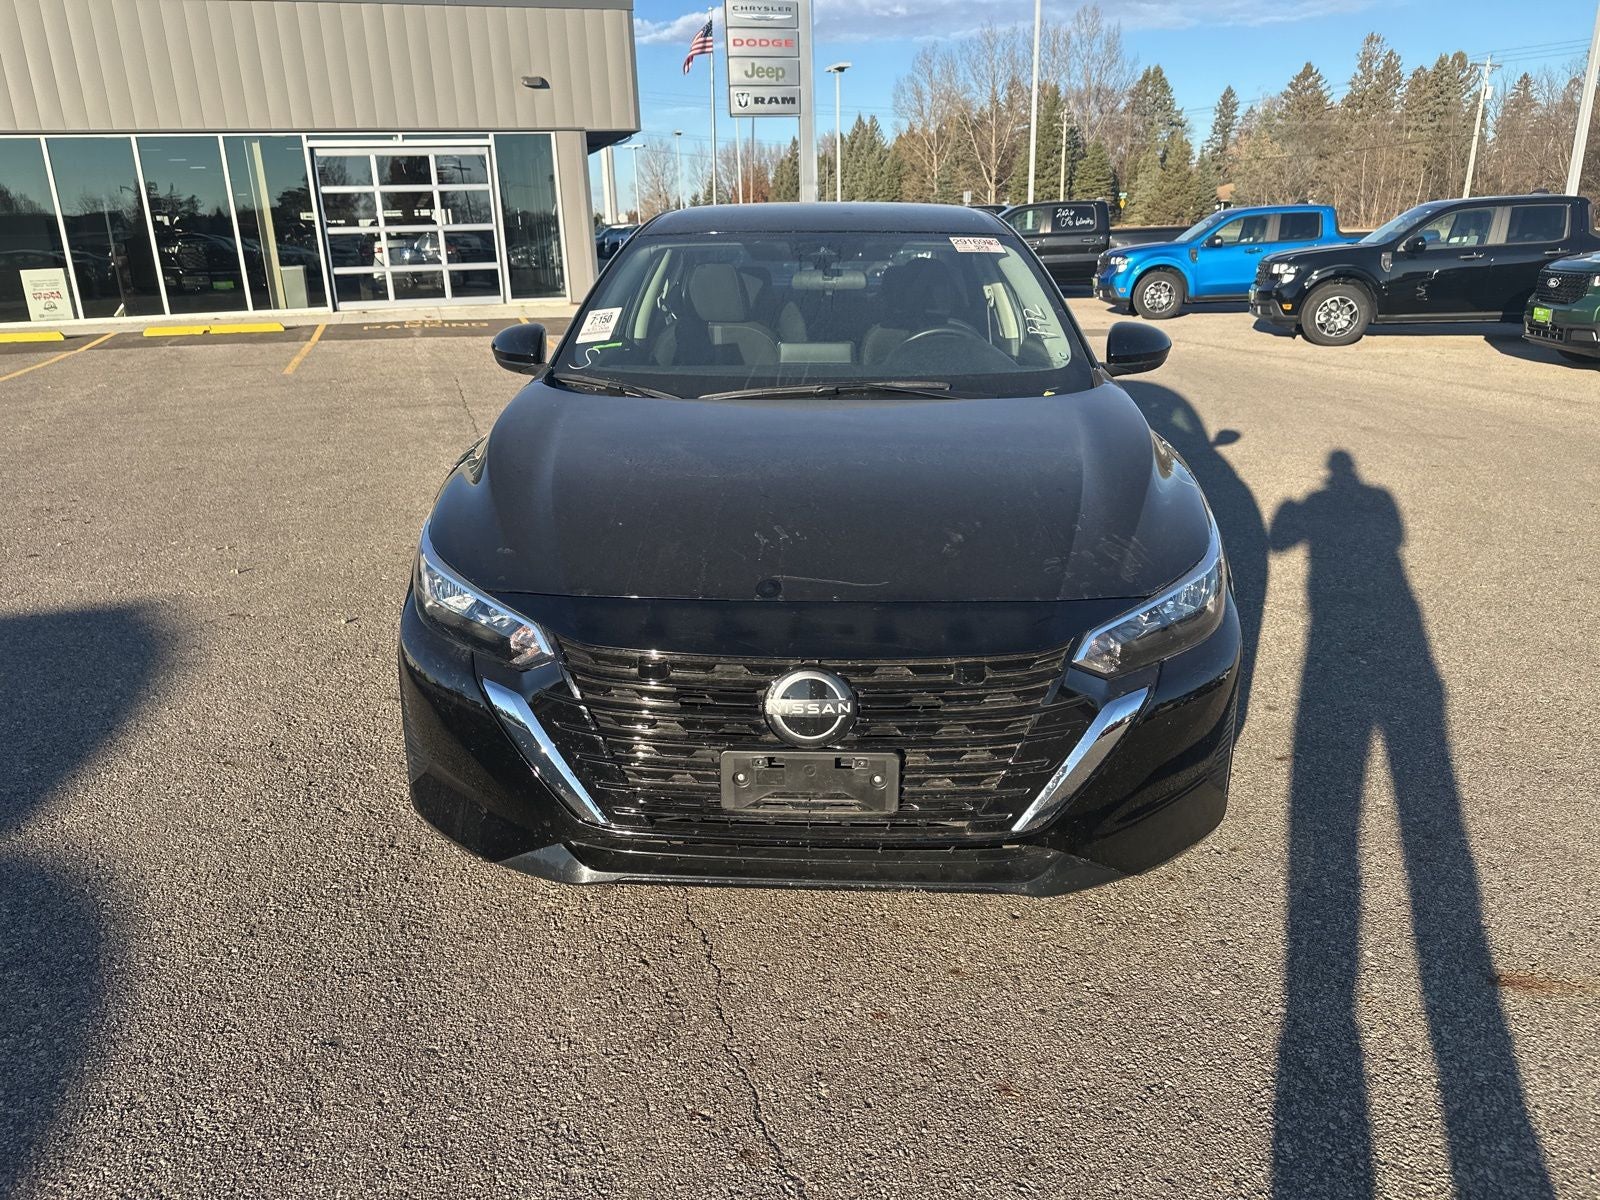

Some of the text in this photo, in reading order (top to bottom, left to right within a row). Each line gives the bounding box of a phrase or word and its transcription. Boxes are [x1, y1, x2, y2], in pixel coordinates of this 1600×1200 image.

[732, 38, 794, 48] DODGE
[744, 62, 786, 81] Jeep
[754, 96, 797, 105] RAM
[768, 703, 851, 715] NISSAN
